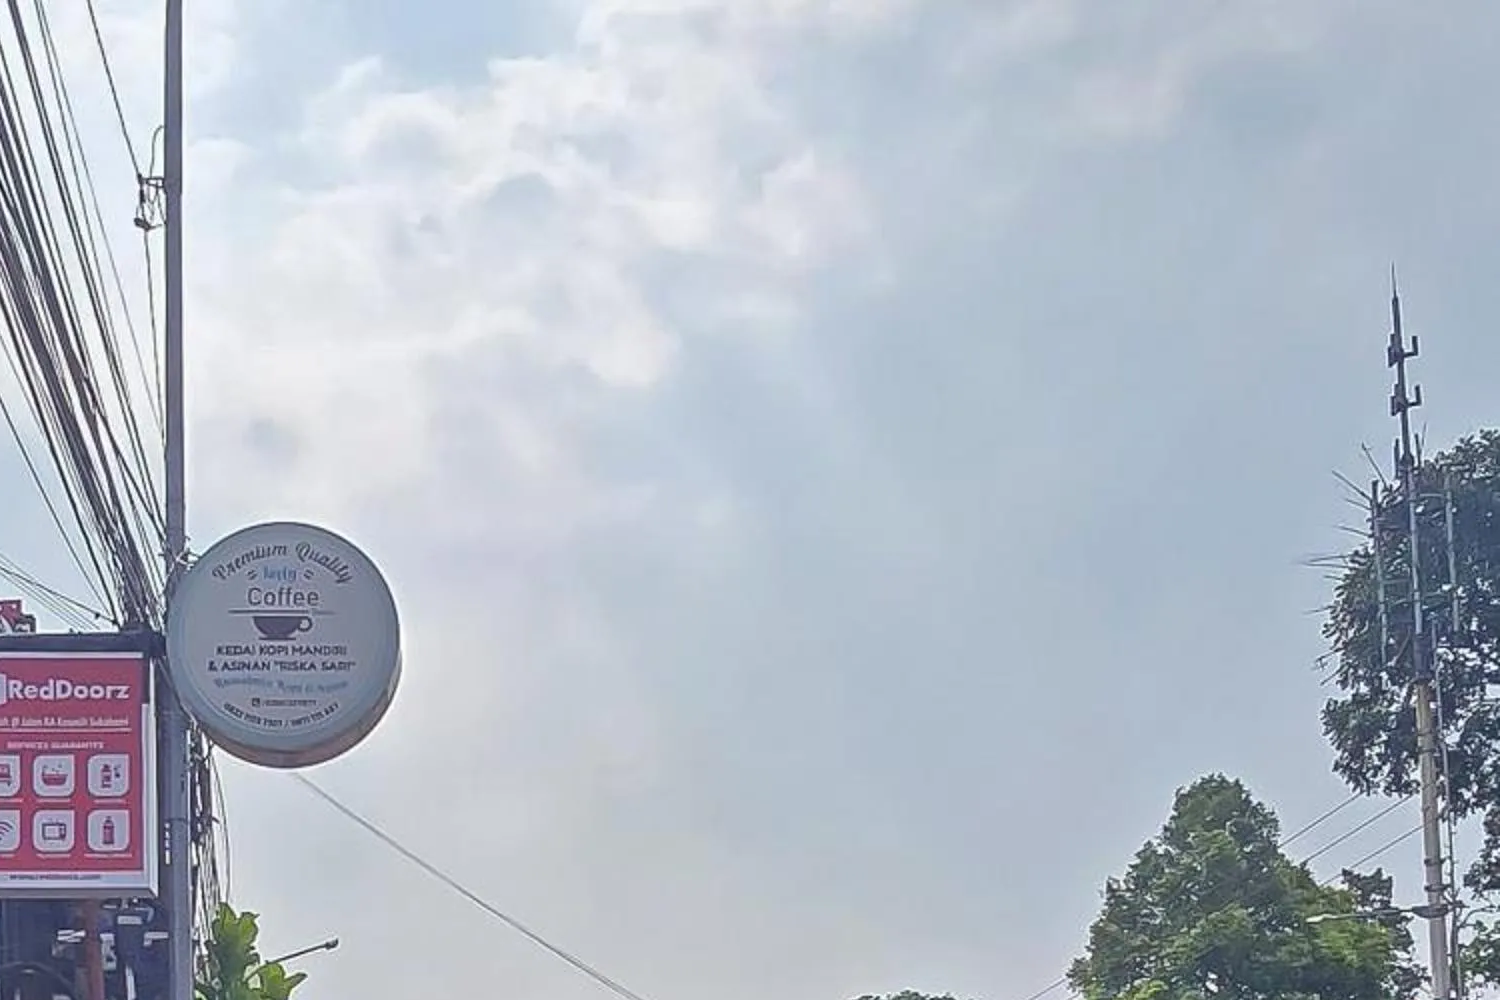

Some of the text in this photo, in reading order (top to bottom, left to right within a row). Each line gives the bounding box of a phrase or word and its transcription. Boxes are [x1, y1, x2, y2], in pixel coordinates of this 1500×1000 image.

[212, 544, 288, 580] Premium
[296, 541, 353, 584] Quality
[247, 587, 320, 607] Coffee
[216, 645, 256, 656] KEDAI
[259, 645, 289, 656] KOPI
[208, 661, 218, 671] &
[221, 661, 271, 671] ASINAN
[8, 678, 130, 700] RedDoorz
